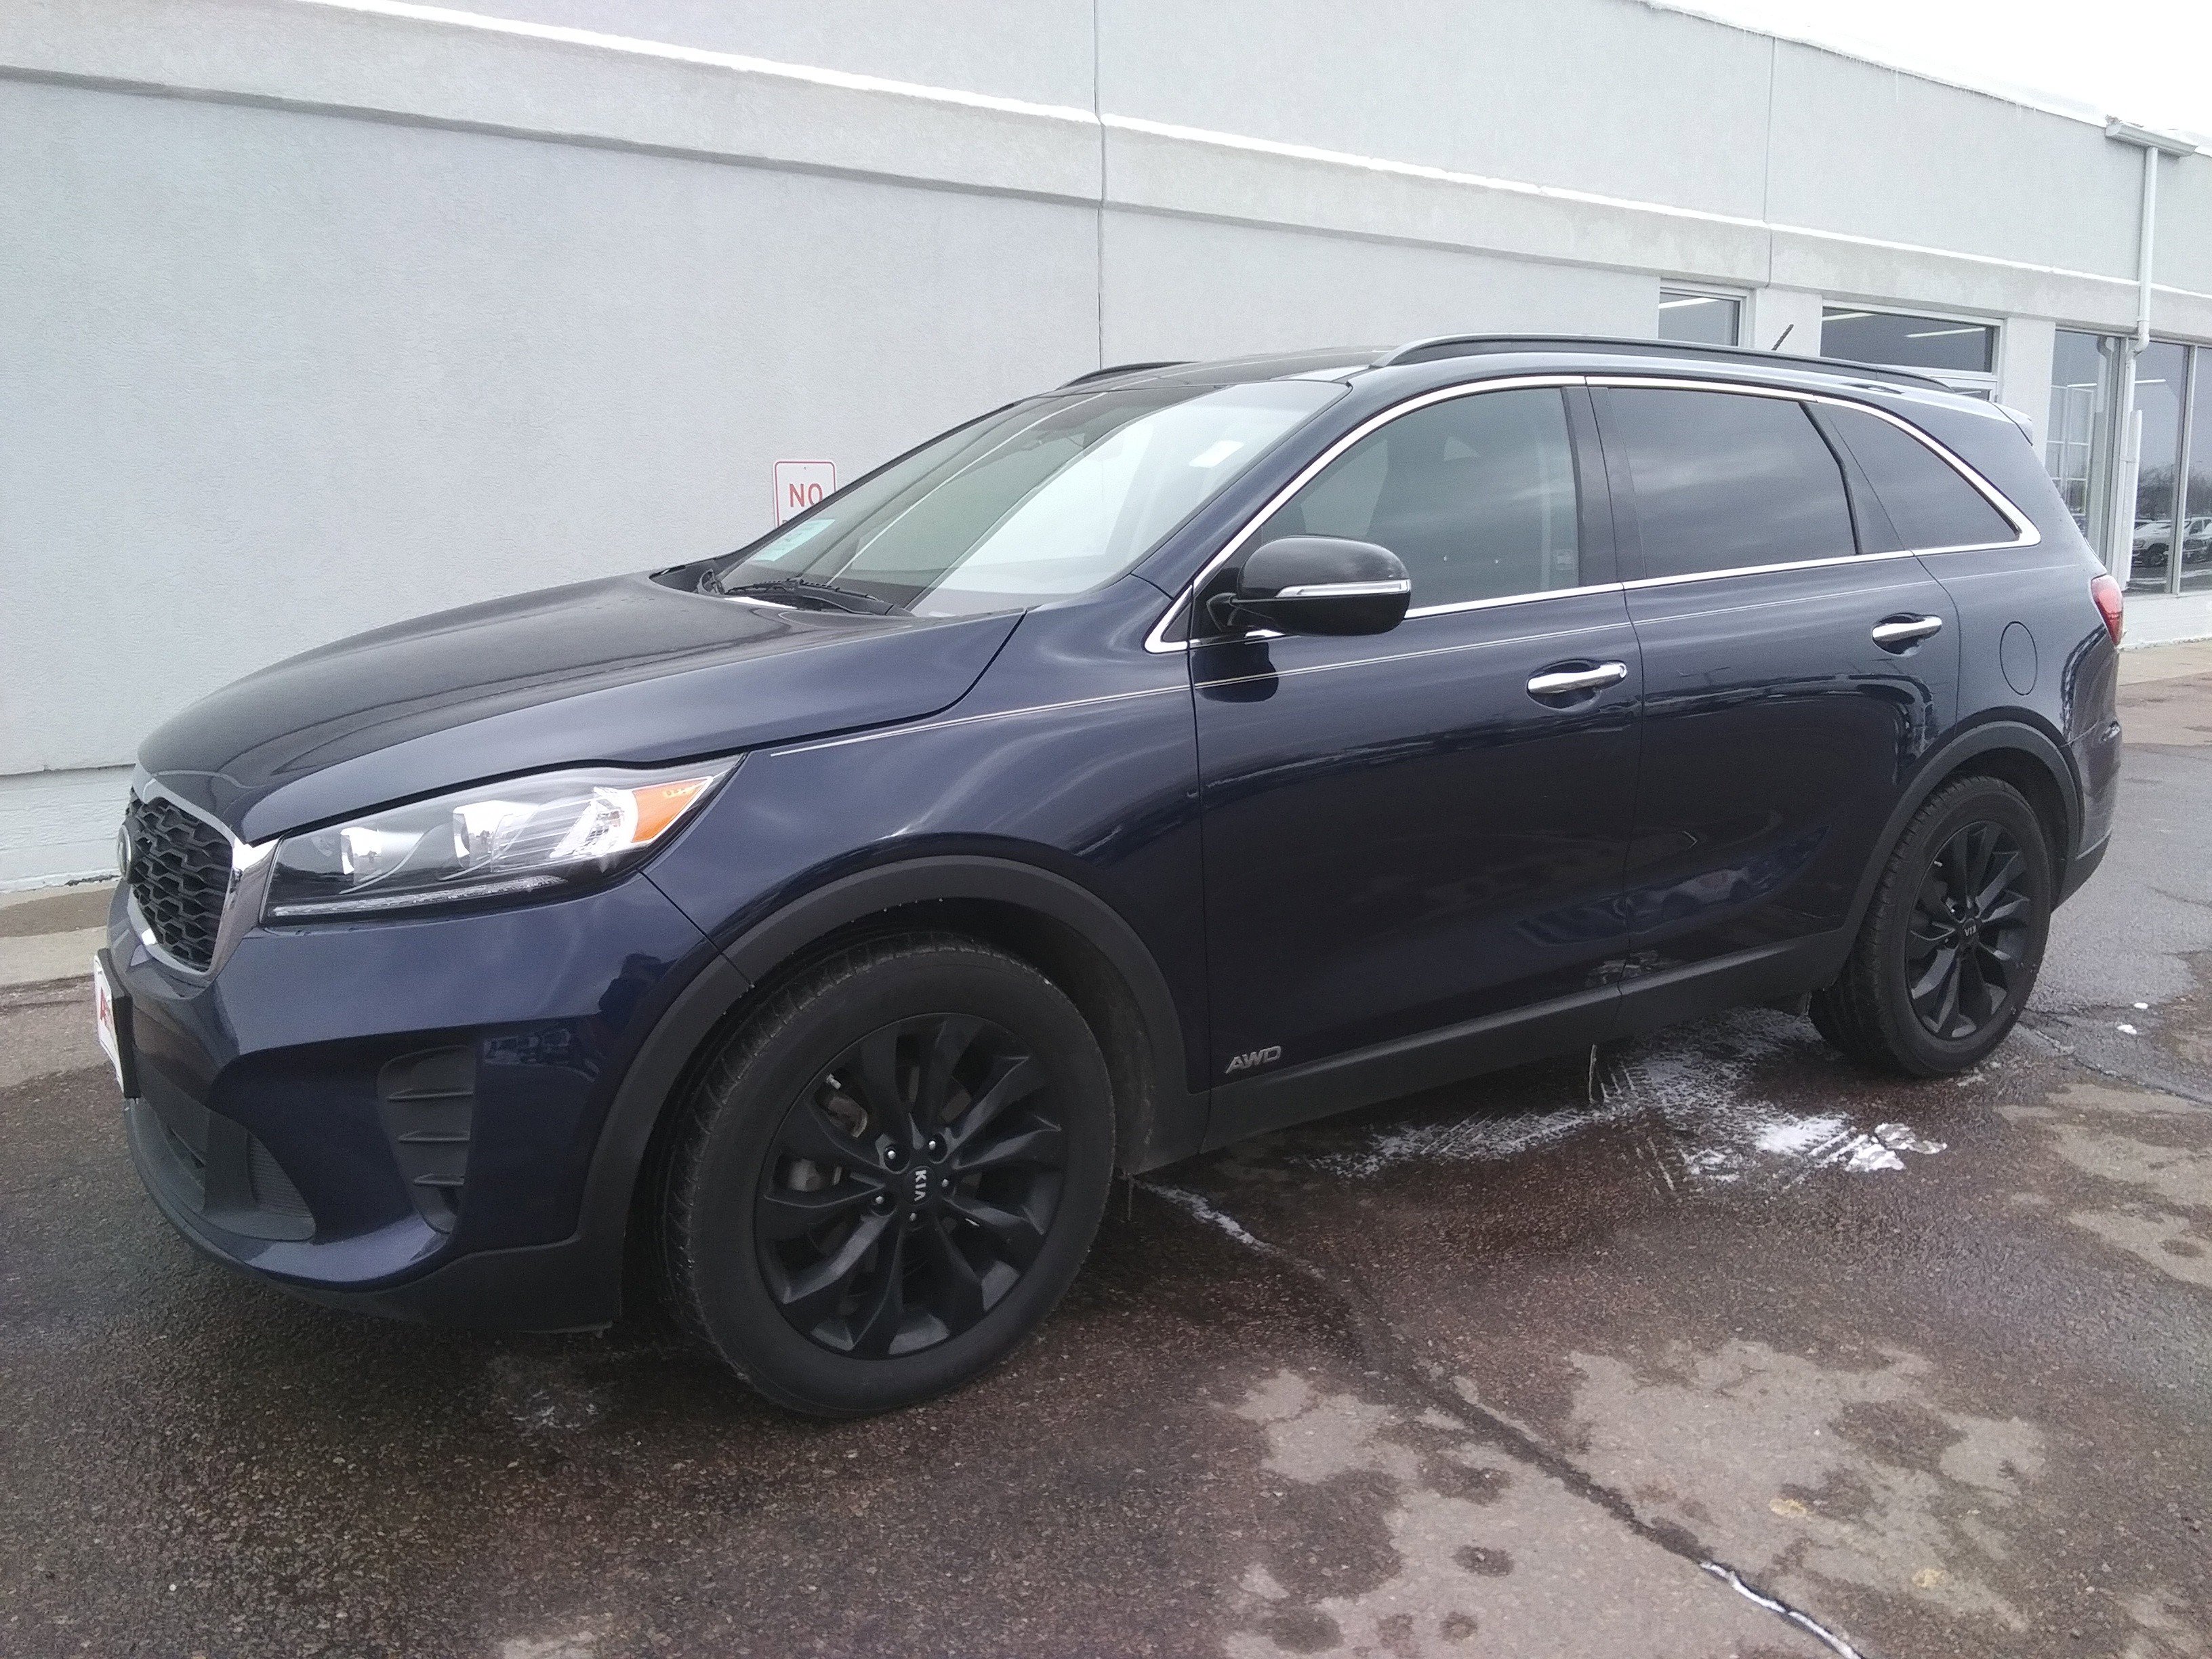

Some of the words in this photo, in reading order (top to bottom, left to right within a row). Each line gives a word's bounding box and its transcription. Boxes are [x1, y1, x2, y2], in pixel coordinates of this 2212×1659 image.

[790, 483, 823, 508] NO
[1225, 1046, 1281, 1073] AWD
[914, 1169, 926, 1202] KIA
